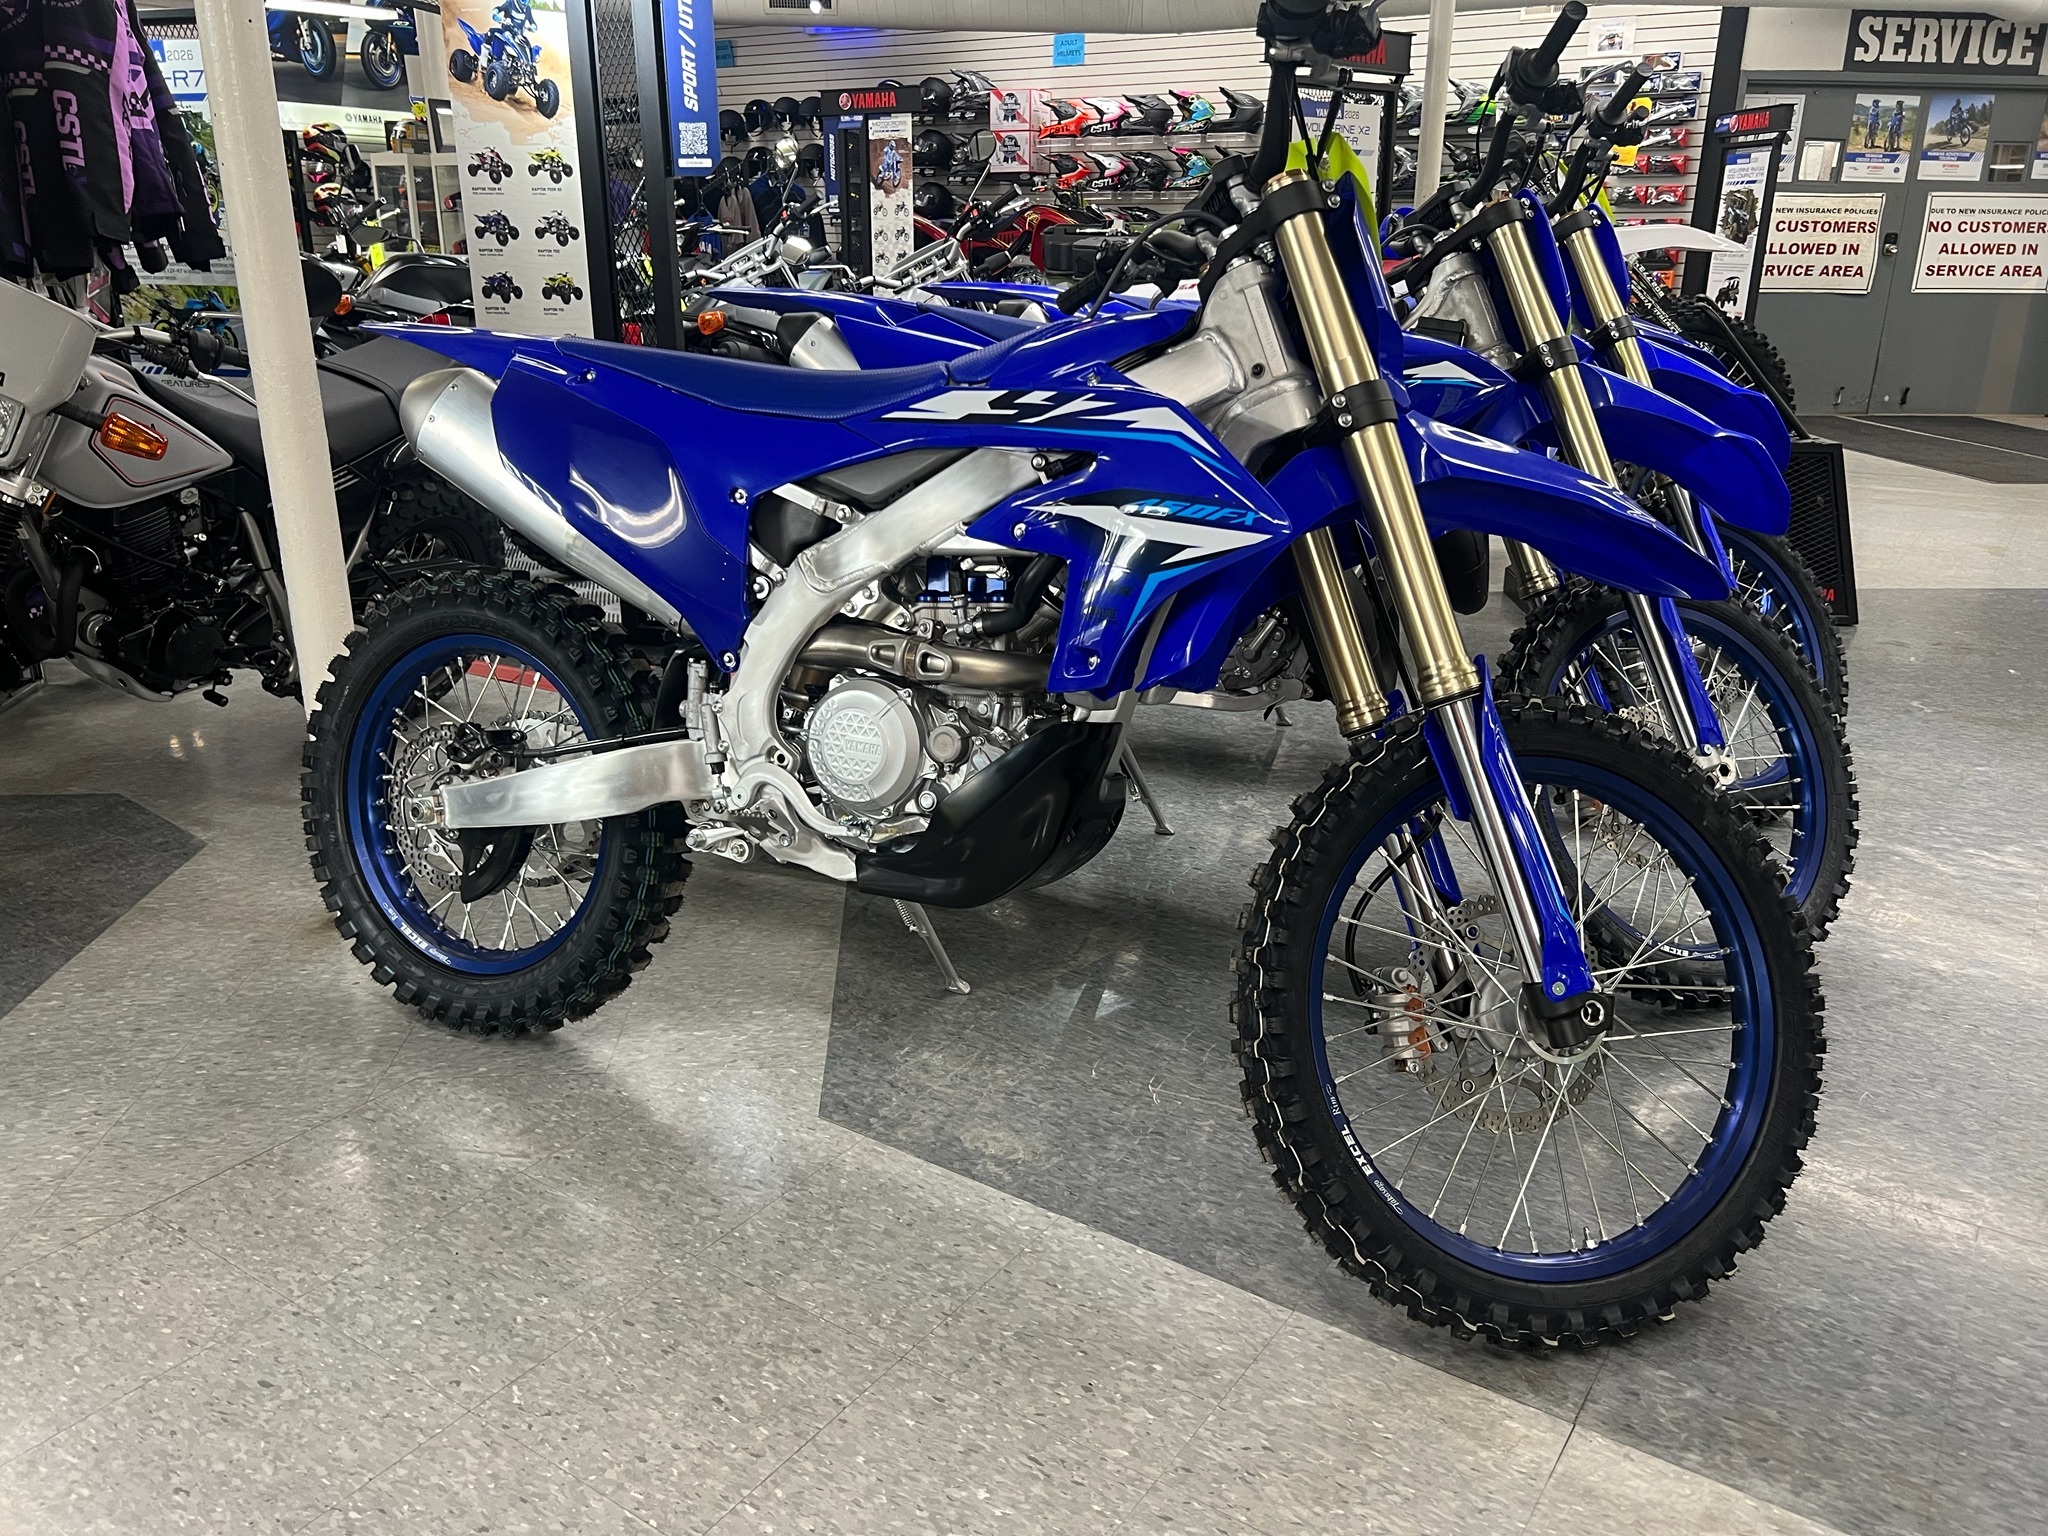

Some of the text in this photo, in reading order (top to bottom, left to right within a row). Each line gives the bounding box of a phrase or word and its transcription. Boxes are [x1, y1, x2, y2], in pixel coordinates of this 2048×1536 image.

[1854, 16, 2040, 66] SERVICE
[167, 50, 193, 60] 2026
[681, 45, 698, 112] SPORT
[852, 92, 896, 108] YAMAHA
[353, 114, 382, 124] YAMAHA
[1345, 110, 1360, 119] 2026
[1739, 111, 1770, 131] YAMAHA
[1090, 121, 1118, 134] CSTLX
[1358, 125, 1370, 135] X2
[829, 133, 837, 180] MOTOCROSS
[1092, 175, 1119, 189] CSTLX
[1775, 220, 1877, 233] CUSTOMERS
[1928, 221, 2048, 233] NO CUSTOMER
[1768, 243, 1860, 255] LLOWED IN
[1938, 243, 2039, 255] ALLOWED IN
[1764, 265, 1815, 277] RVICE
[1819, 265, 1864, 277] AREA
[1925, 265, 2042, 277] SERVICE AREA
[1119, 498, 1261, 526] 450FX
[845, 739, 882, 756] YAMAHA
[400, 922, 429, 950] EXCEL
[1341, 1124, 1374, 1177] EXCEL
[1373, 1179, 1403, 1215] Takasago
